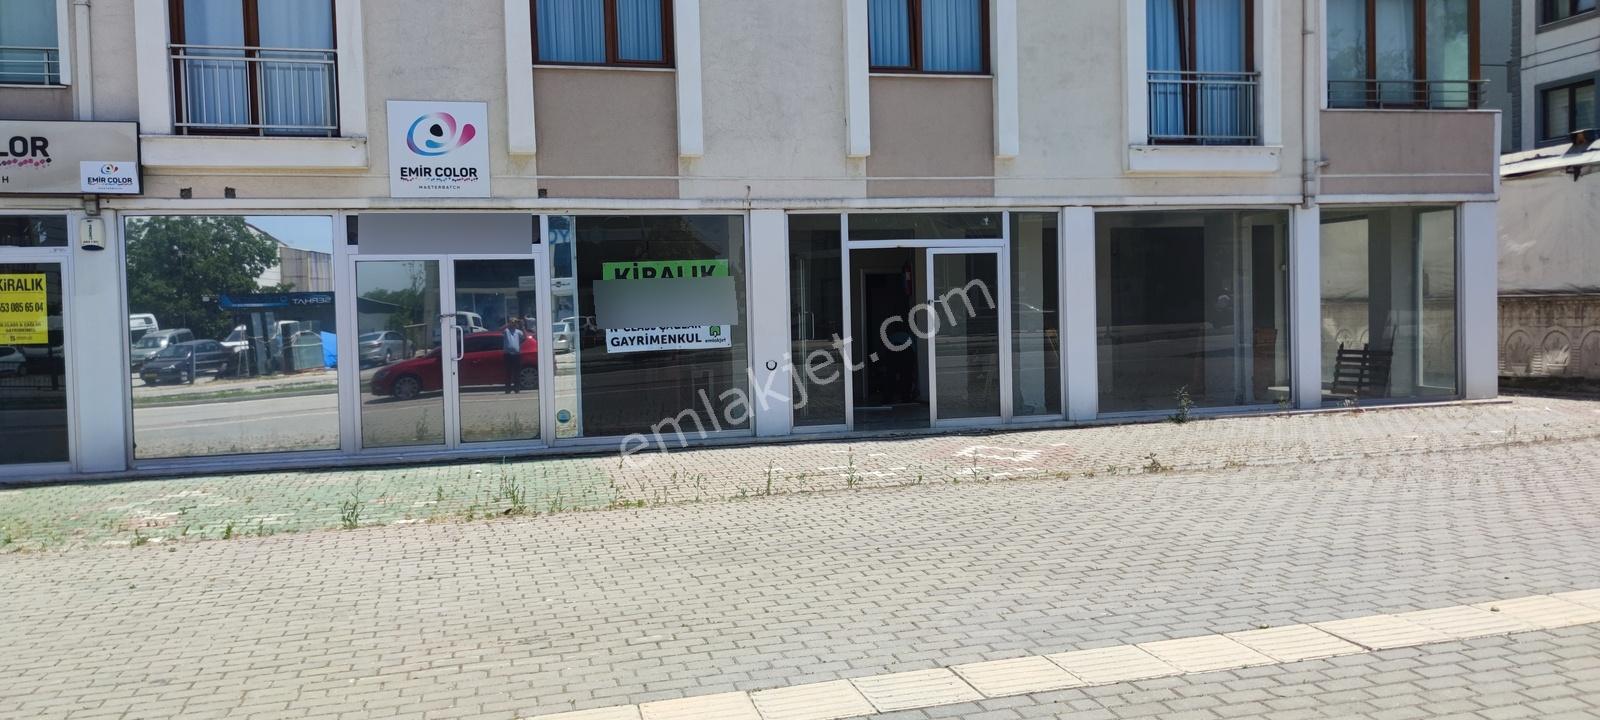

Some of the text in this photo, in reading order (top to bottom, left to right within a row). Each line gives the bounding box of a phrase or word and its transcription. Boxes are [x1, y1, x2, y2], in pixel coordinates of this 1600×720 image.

[400, 165, 477, 177] EMİR COLOR
[610, 333, 702, 346] GAYRİMENKUL
